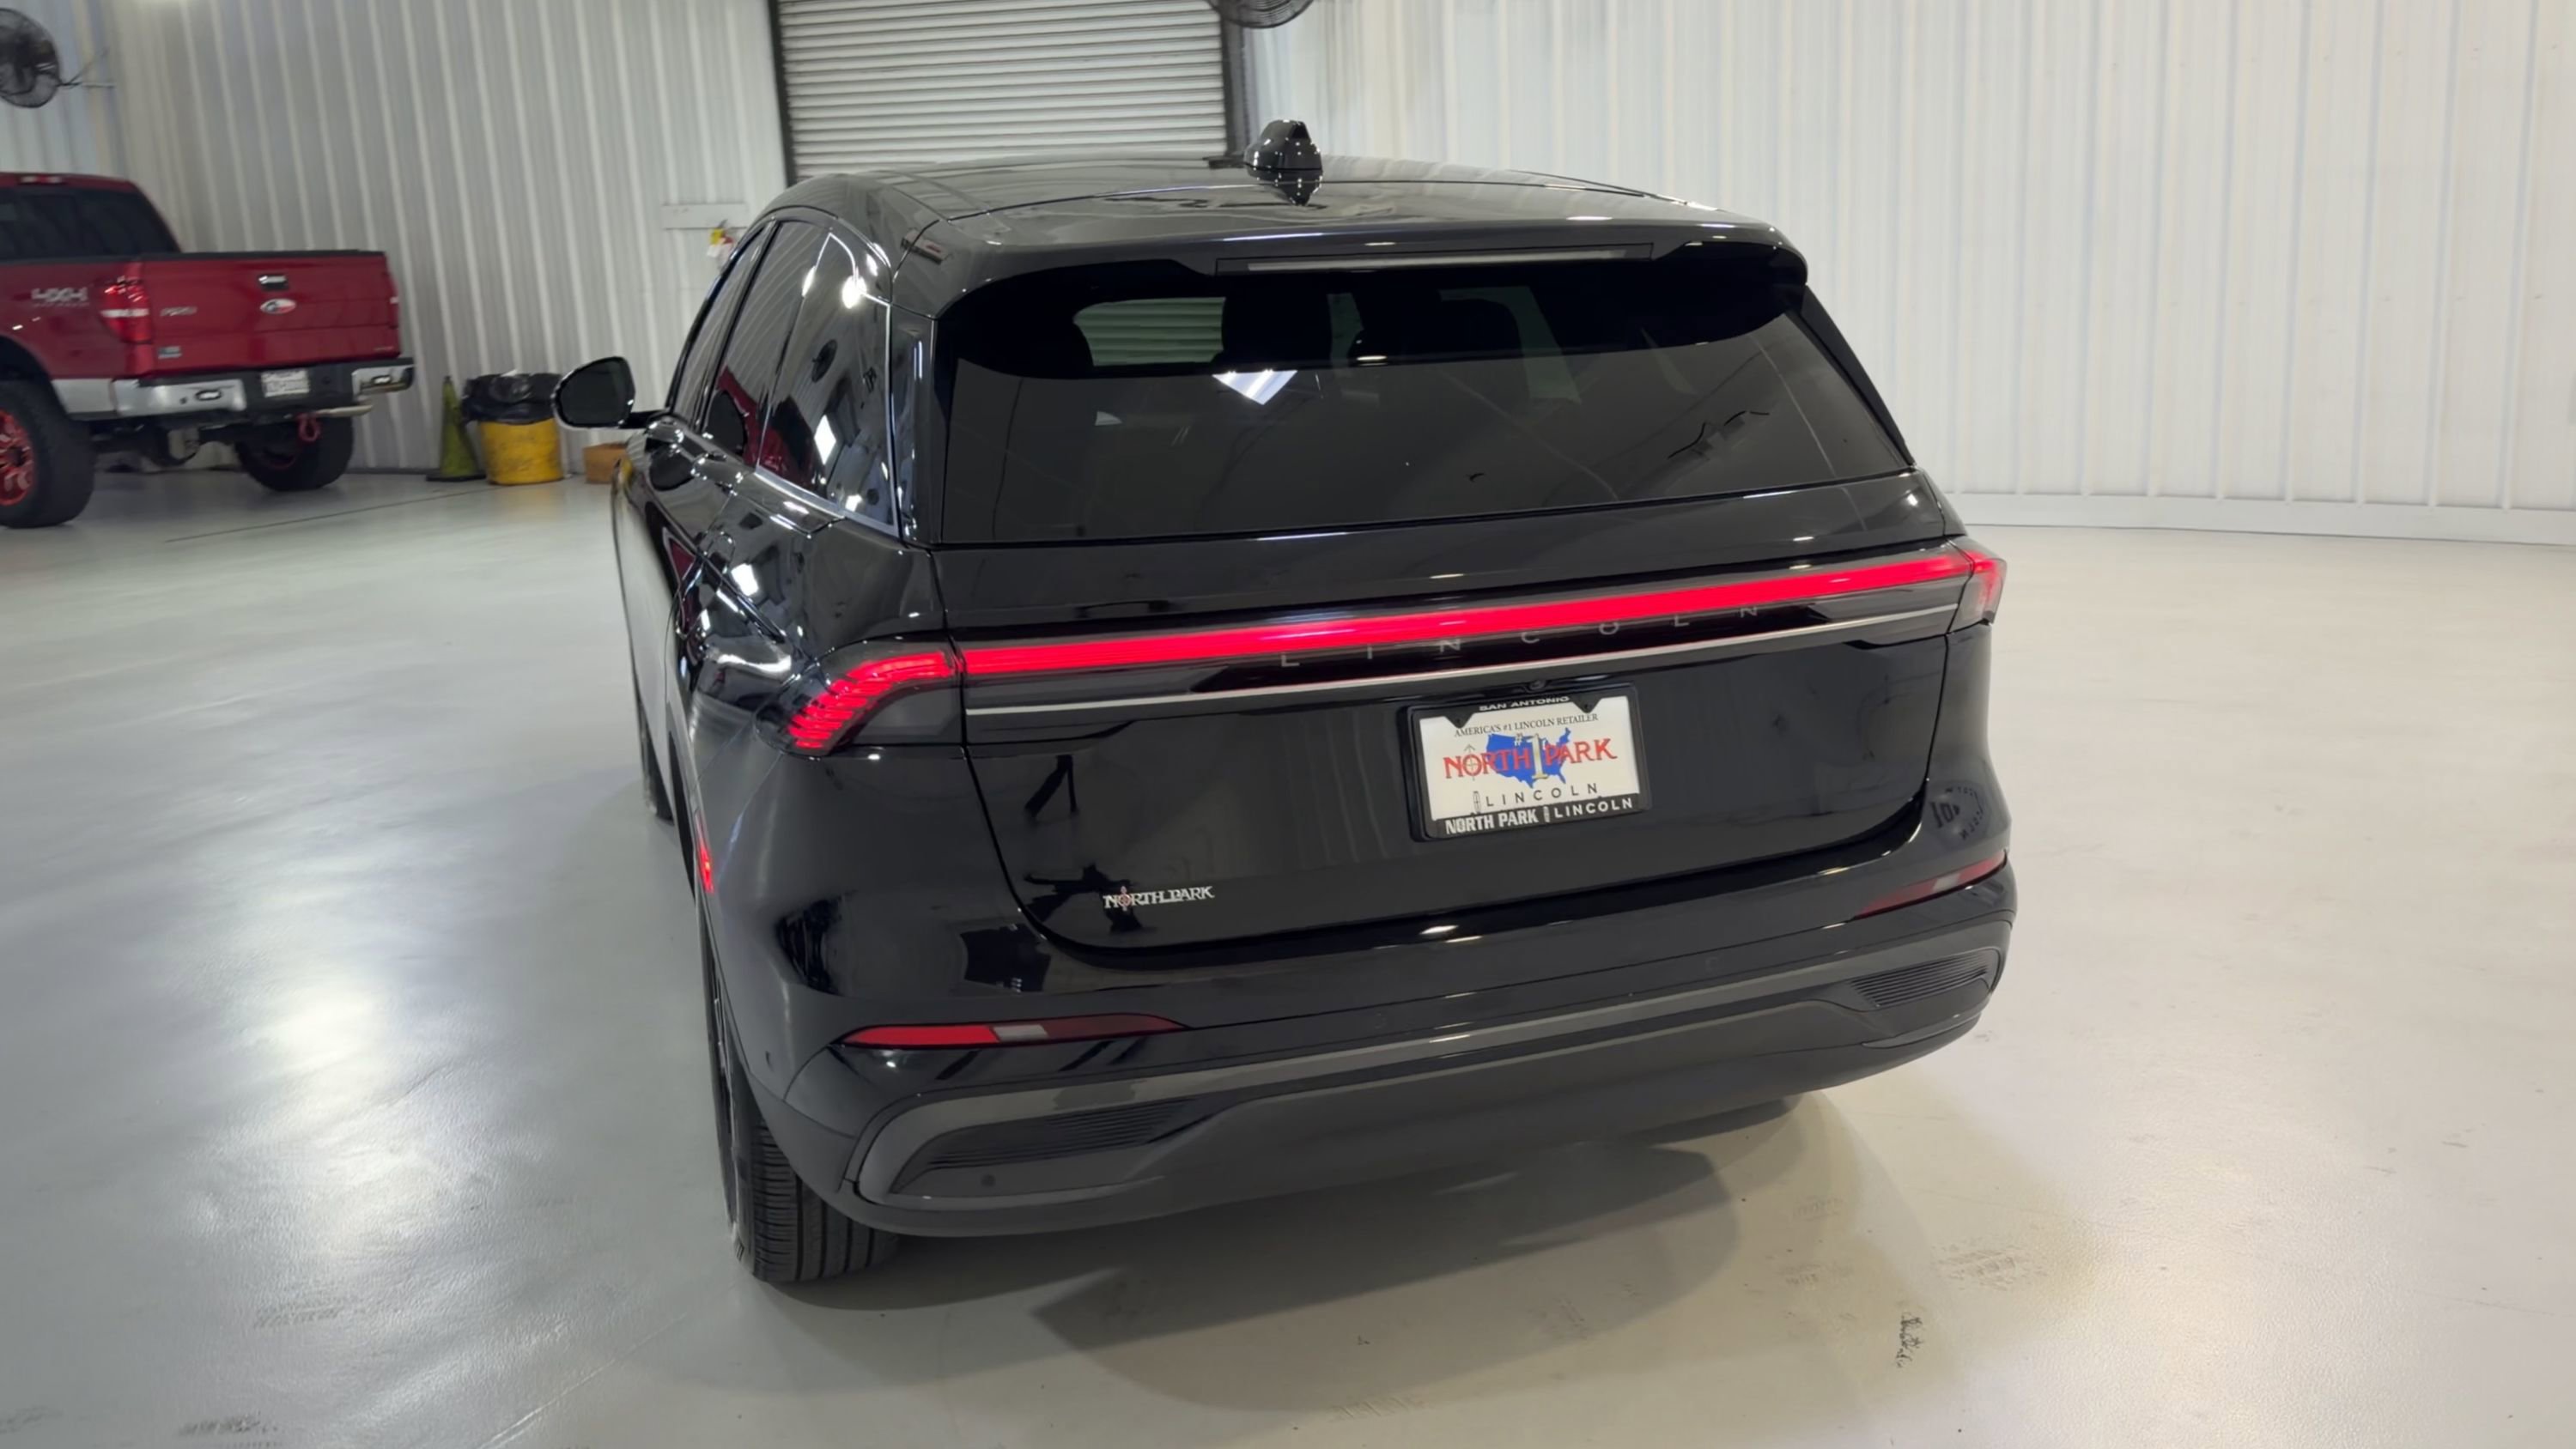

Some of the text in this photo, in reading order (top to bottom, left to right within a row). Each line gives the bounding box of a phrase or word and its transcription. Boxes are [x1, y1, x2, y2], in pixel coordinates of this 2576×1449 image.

[1280, 603, 1759, 668] LINCOLN
[1479, 696, 1571, 712] SAN ANTONIO
[1514, 718, 1555, 730] LINCOLN
[1556, 713, 1599, 726] RETAILER
[1443, 738, 1618, 779] NORTH PARK
[1485, 782, 1599, 808] LINCOLN
[1445, 797, 1633, 834] NORTH PARK LINCOLN
